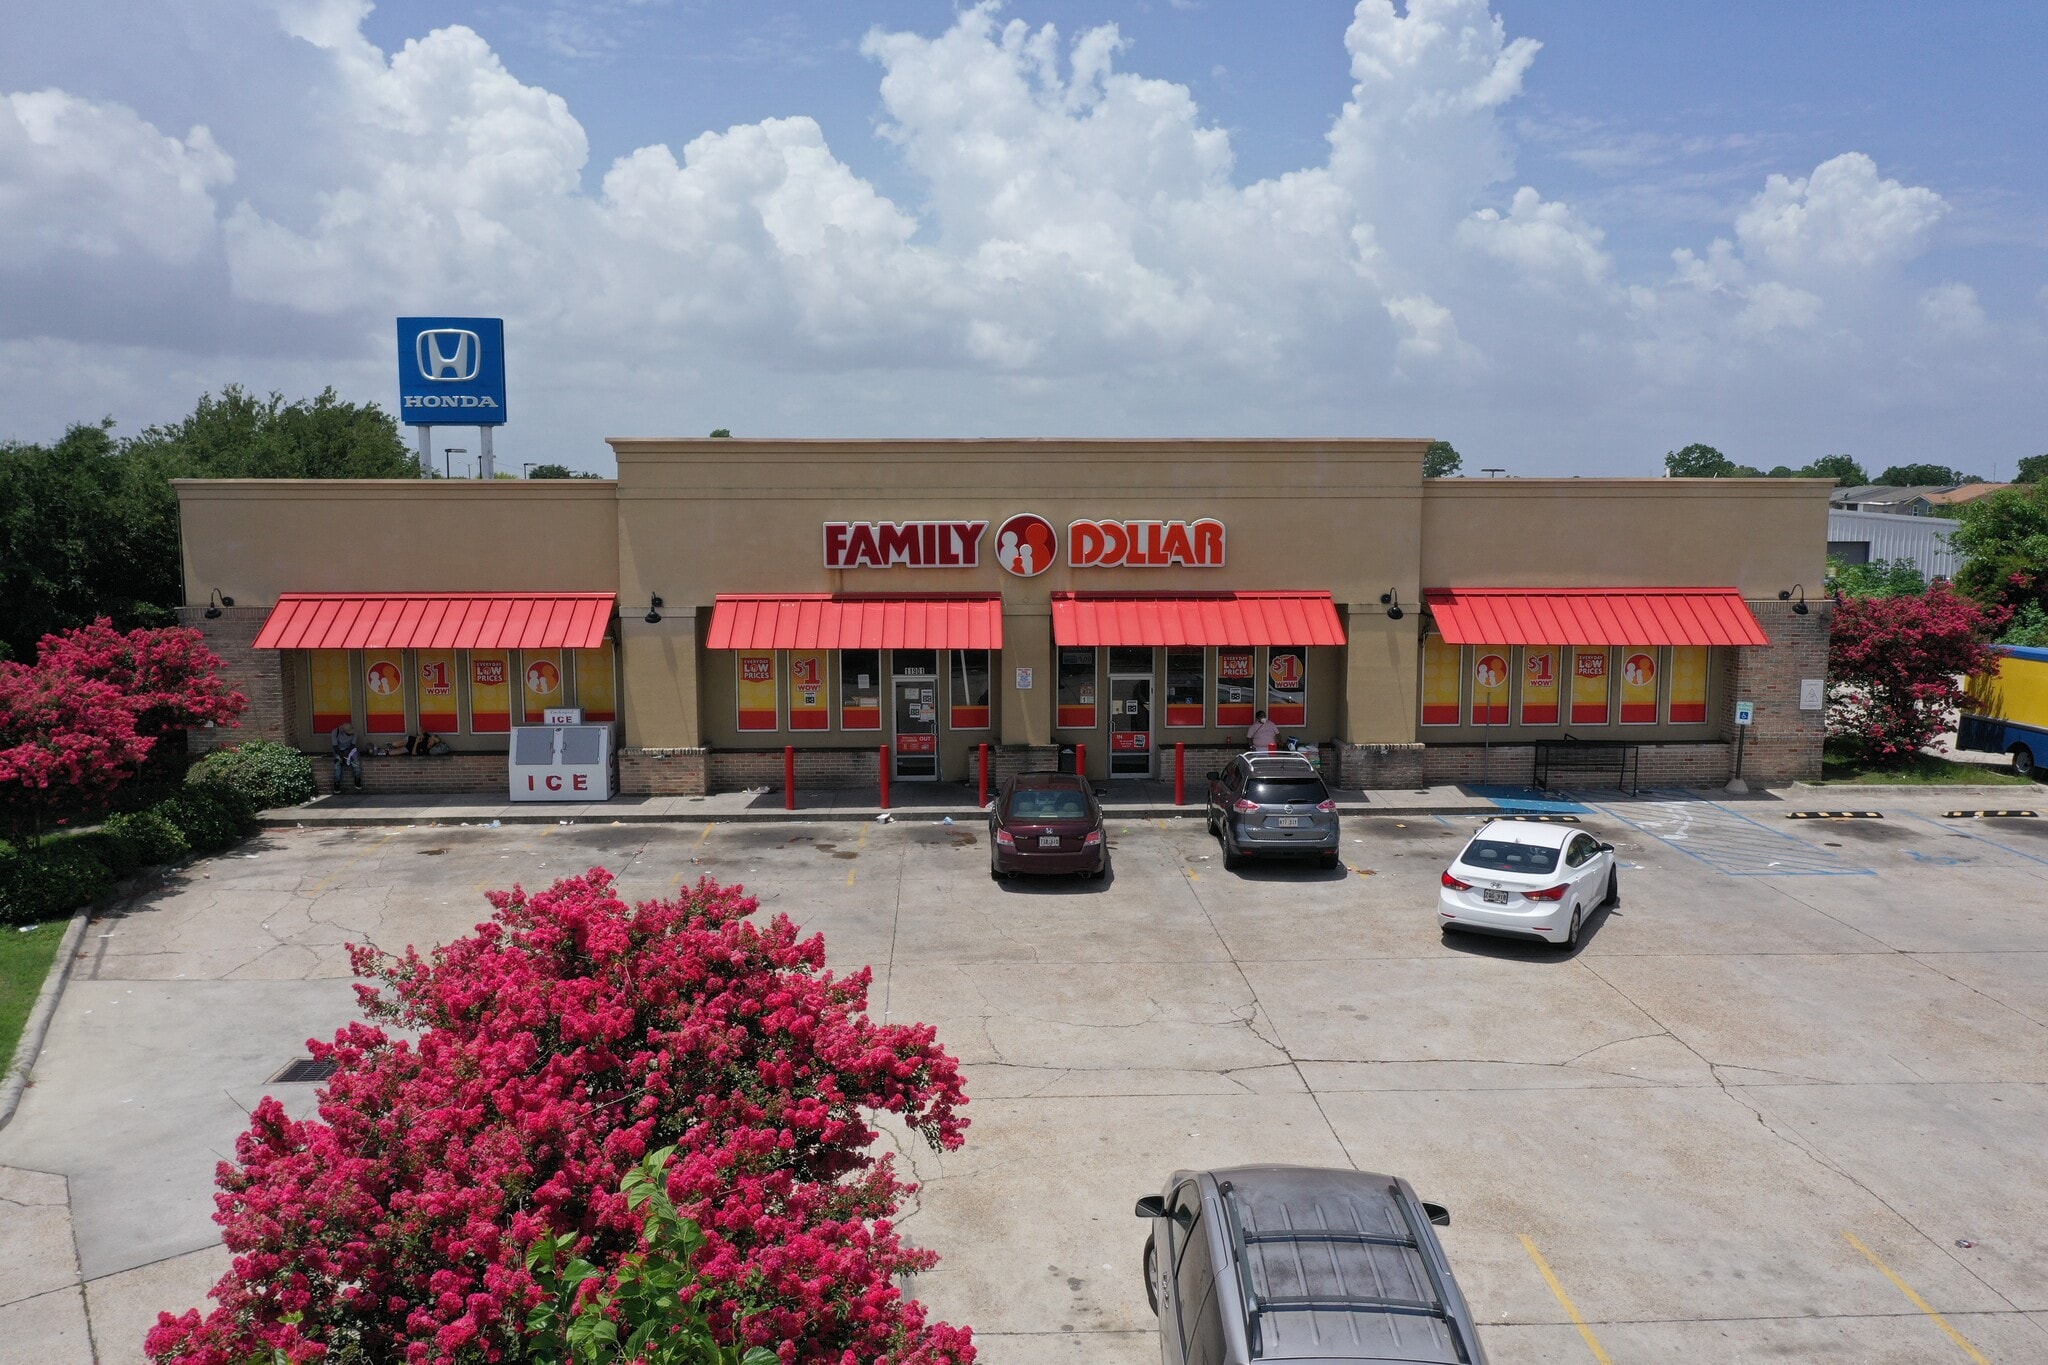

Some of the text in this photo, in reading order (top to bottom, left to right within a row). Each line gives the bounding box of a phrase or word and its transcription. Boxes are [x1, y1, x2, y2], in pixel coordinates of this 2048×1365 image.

[403, 395, 499, 408] HONDA
[824, 520, 1225, 567] FAMILY DOLLAR
[476, 666, 502, 675] LOW
[744, 664, 769, 673] LOW
[794, 658, 821, 684] $1
[1223, 660, 1248, 669] LOW
[1273, 656, 1298, 681] $1
[1528, 654, 1553, 680] $1
[1578, 659, 1603, 668] LOW
[422, 661, 450, 688] $1
[551, 716, 573, 724] ICE
[527, 773, 588, 792] ICE
